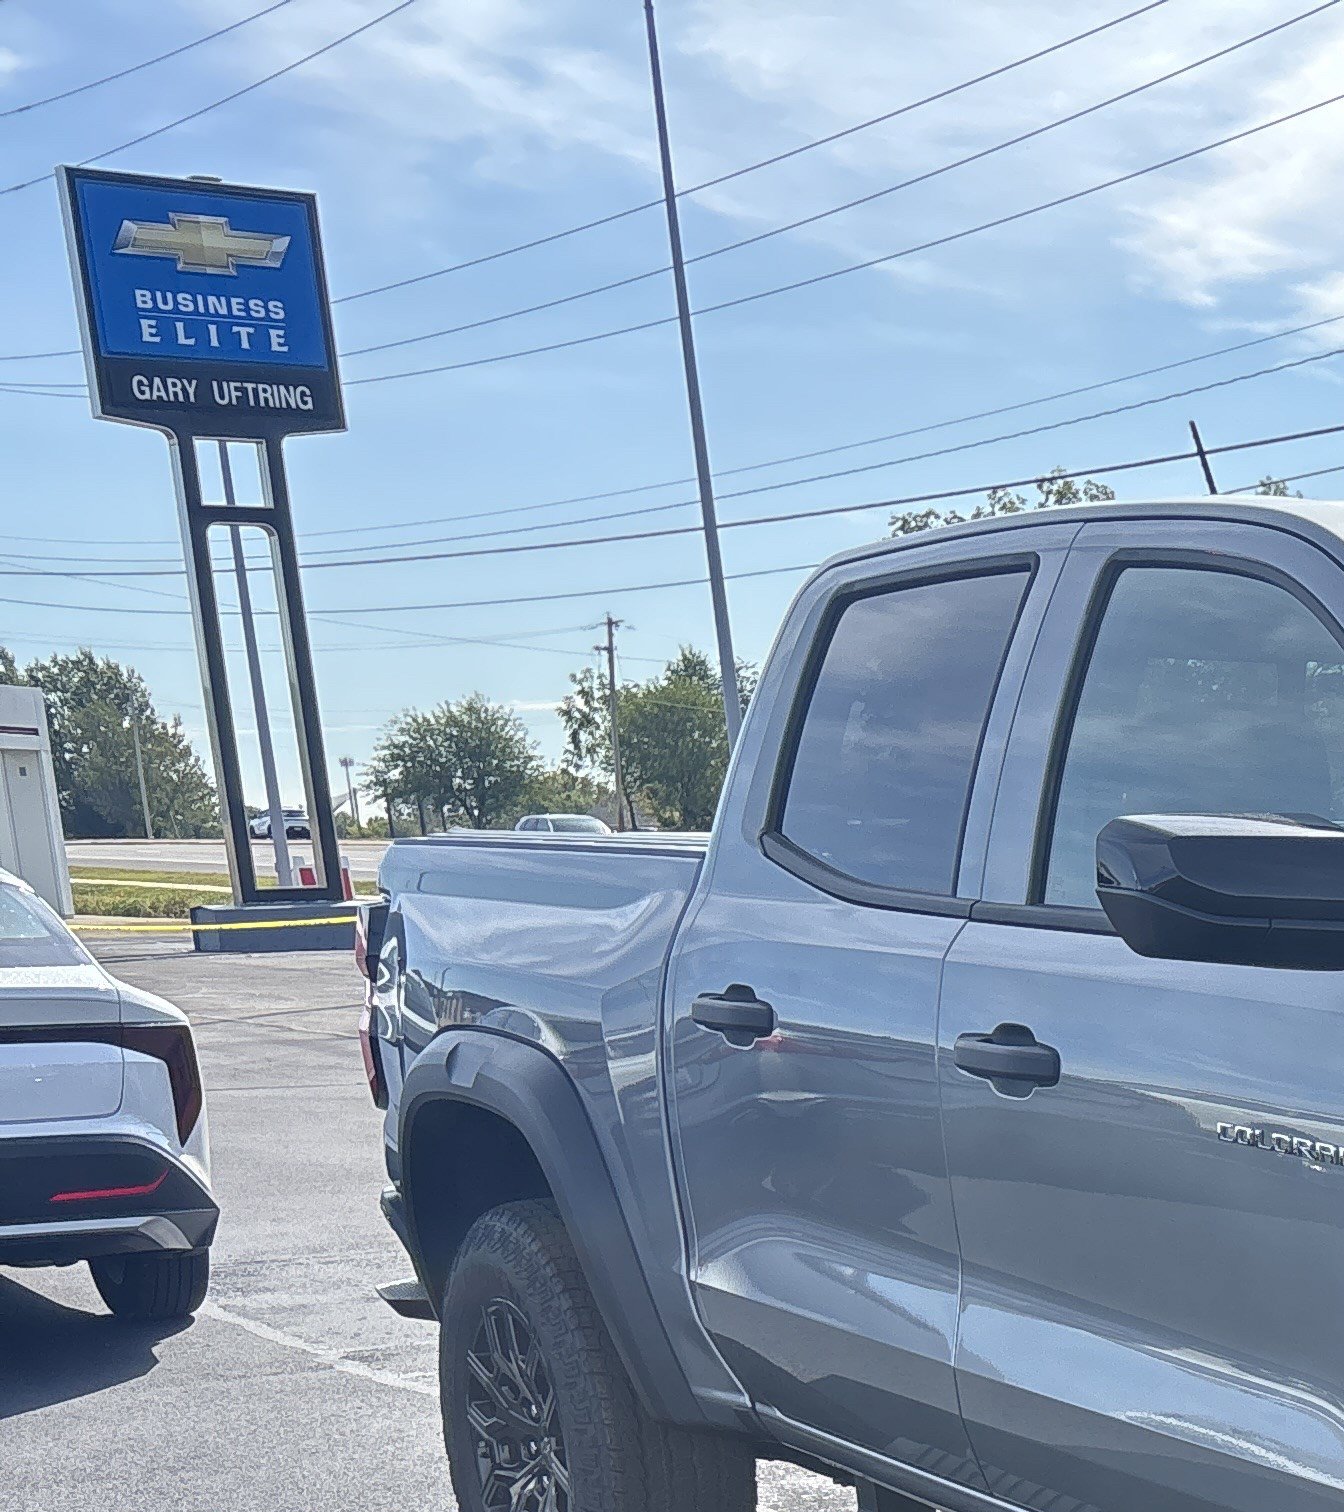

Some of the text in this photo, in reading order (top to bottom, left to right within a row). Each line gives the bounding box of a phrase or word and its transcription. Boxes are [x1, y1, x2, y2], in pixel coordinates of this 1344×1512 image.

[134, 288, 286, 319] BUSINESS
[140, 318, 289, 353] ELITE
[132, 374, 314, 411] GARY UFTRING
